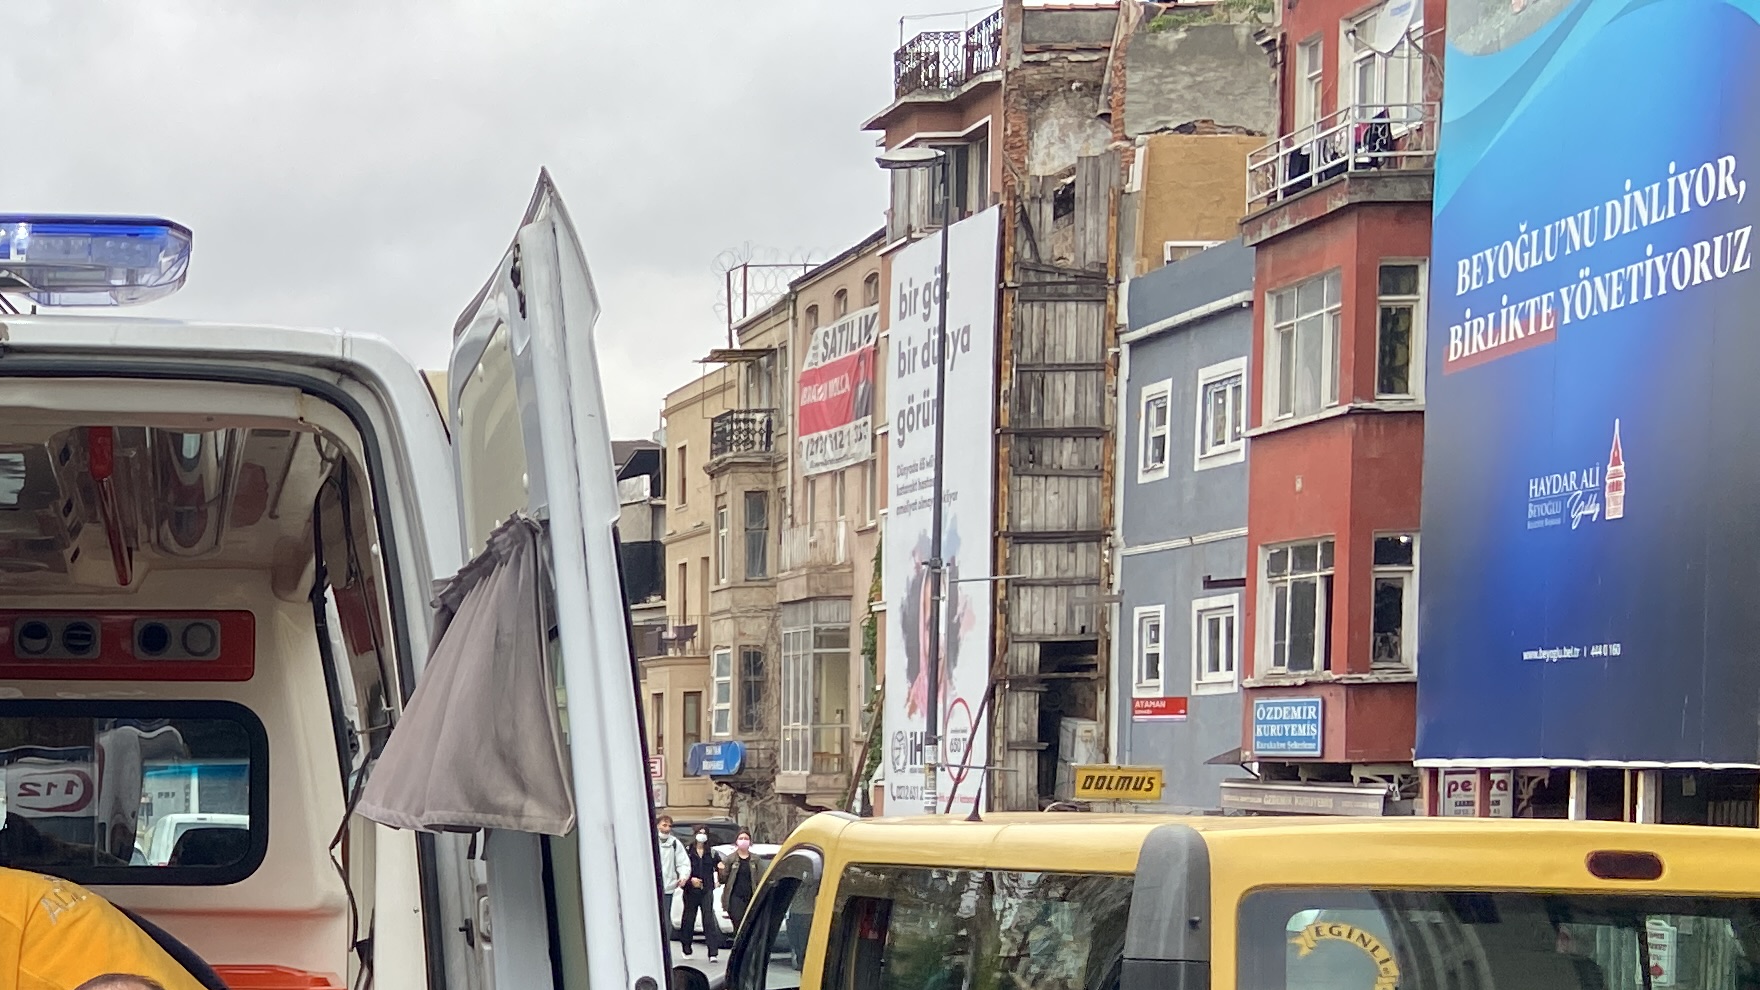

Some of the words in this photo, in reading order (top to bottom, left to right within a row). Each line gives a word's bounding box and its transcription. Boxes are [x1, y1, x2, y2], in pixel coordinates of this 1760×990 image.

[1456, 205, 1601, 296] BEYOĞLU'NU
[1604, 154, 1747, 242] DİNLİYOR,
[898, 277, 919, 321] bir
[1447, 294, 1556, 362] BİRLİKTE
[1559, 225, 1753, 325] YÖNETİYORUZ
[821, 312, 878, 363] SATILIK
[897, 336, 918, 379] bir
[1529, 471, 1578, 499] HAYDAR
[1580, 461, 1600, 490] ALİ
[1134, 700, 1166, 709] ATAMAN
[1256, 702, 1318, 721] ÖZDEMİR
[1255, 720, 1318, 740] KURUYEMİŞ
